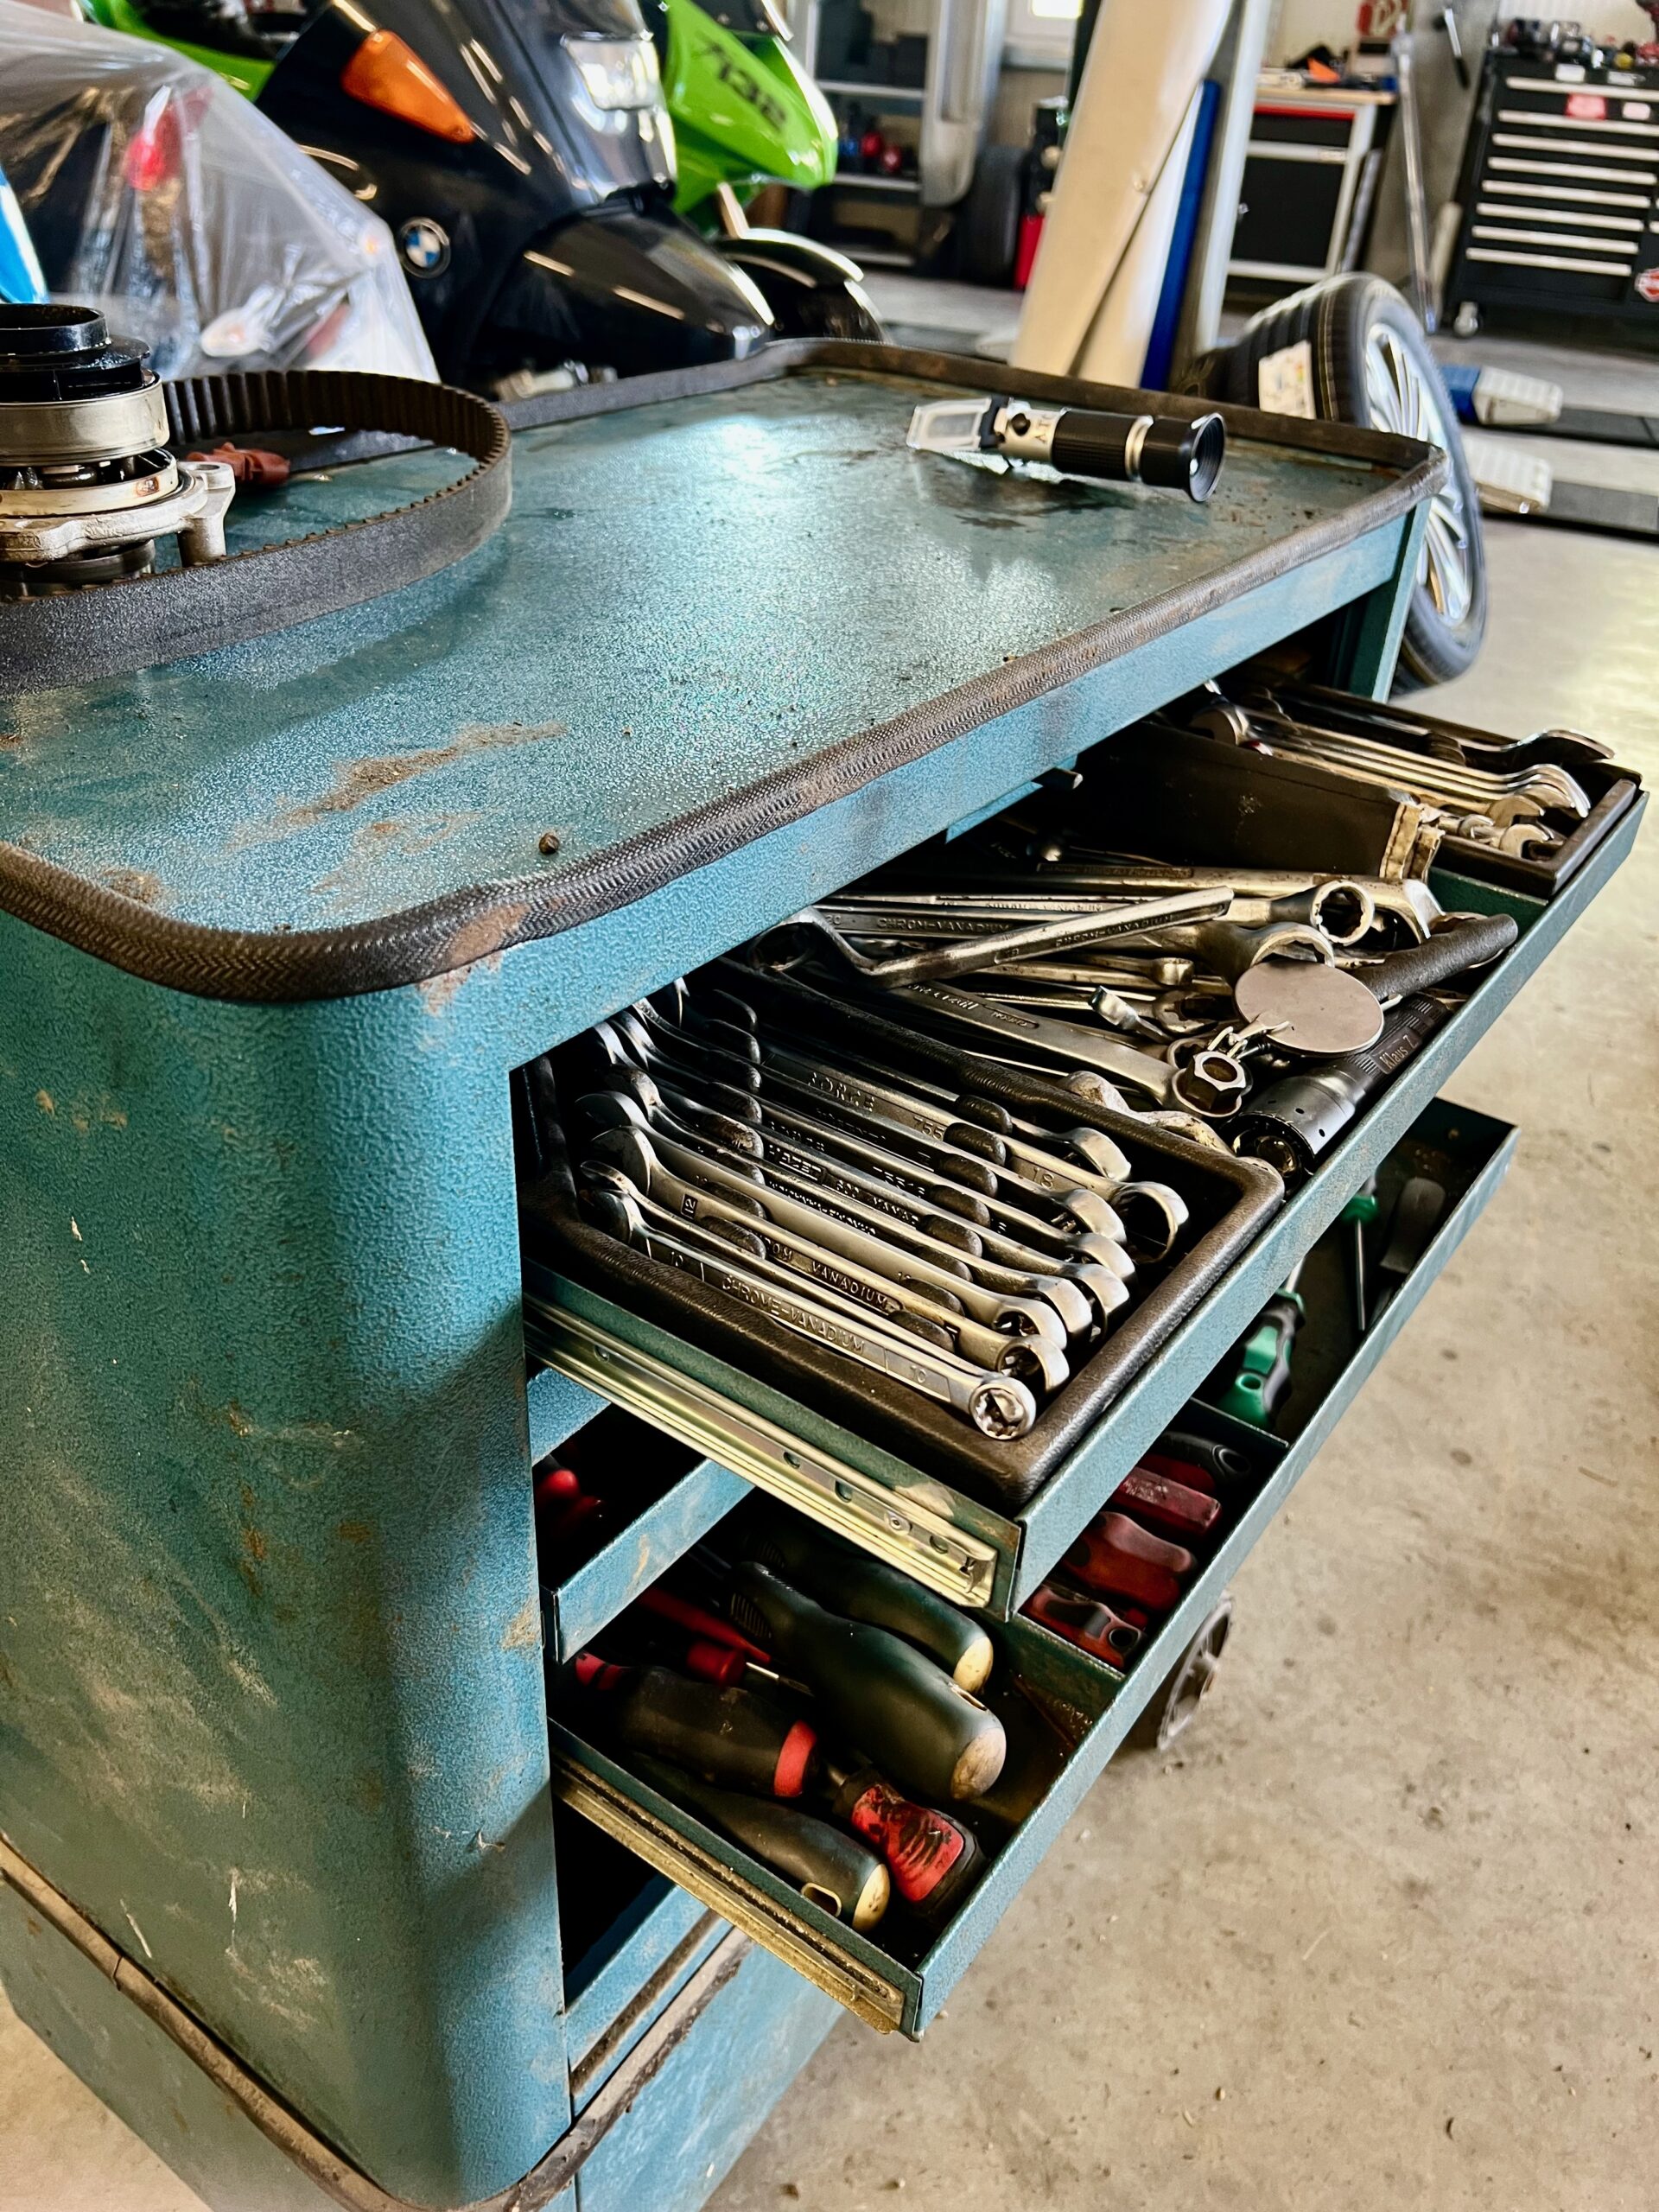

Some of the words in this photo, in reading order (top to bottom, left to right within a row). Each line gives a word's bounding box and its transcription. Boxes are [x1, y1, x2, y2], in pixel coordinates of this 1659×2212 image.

[1379, 1046, 1408, 1070] Klaus
[1033, 1166, 1054, 1190] 18
[810, 1260, 888, 1306] VANADIUM
[721, 1274, 865, 1353] CHROME-VANADIUM
[910, 1365, 927, 1384] 10
